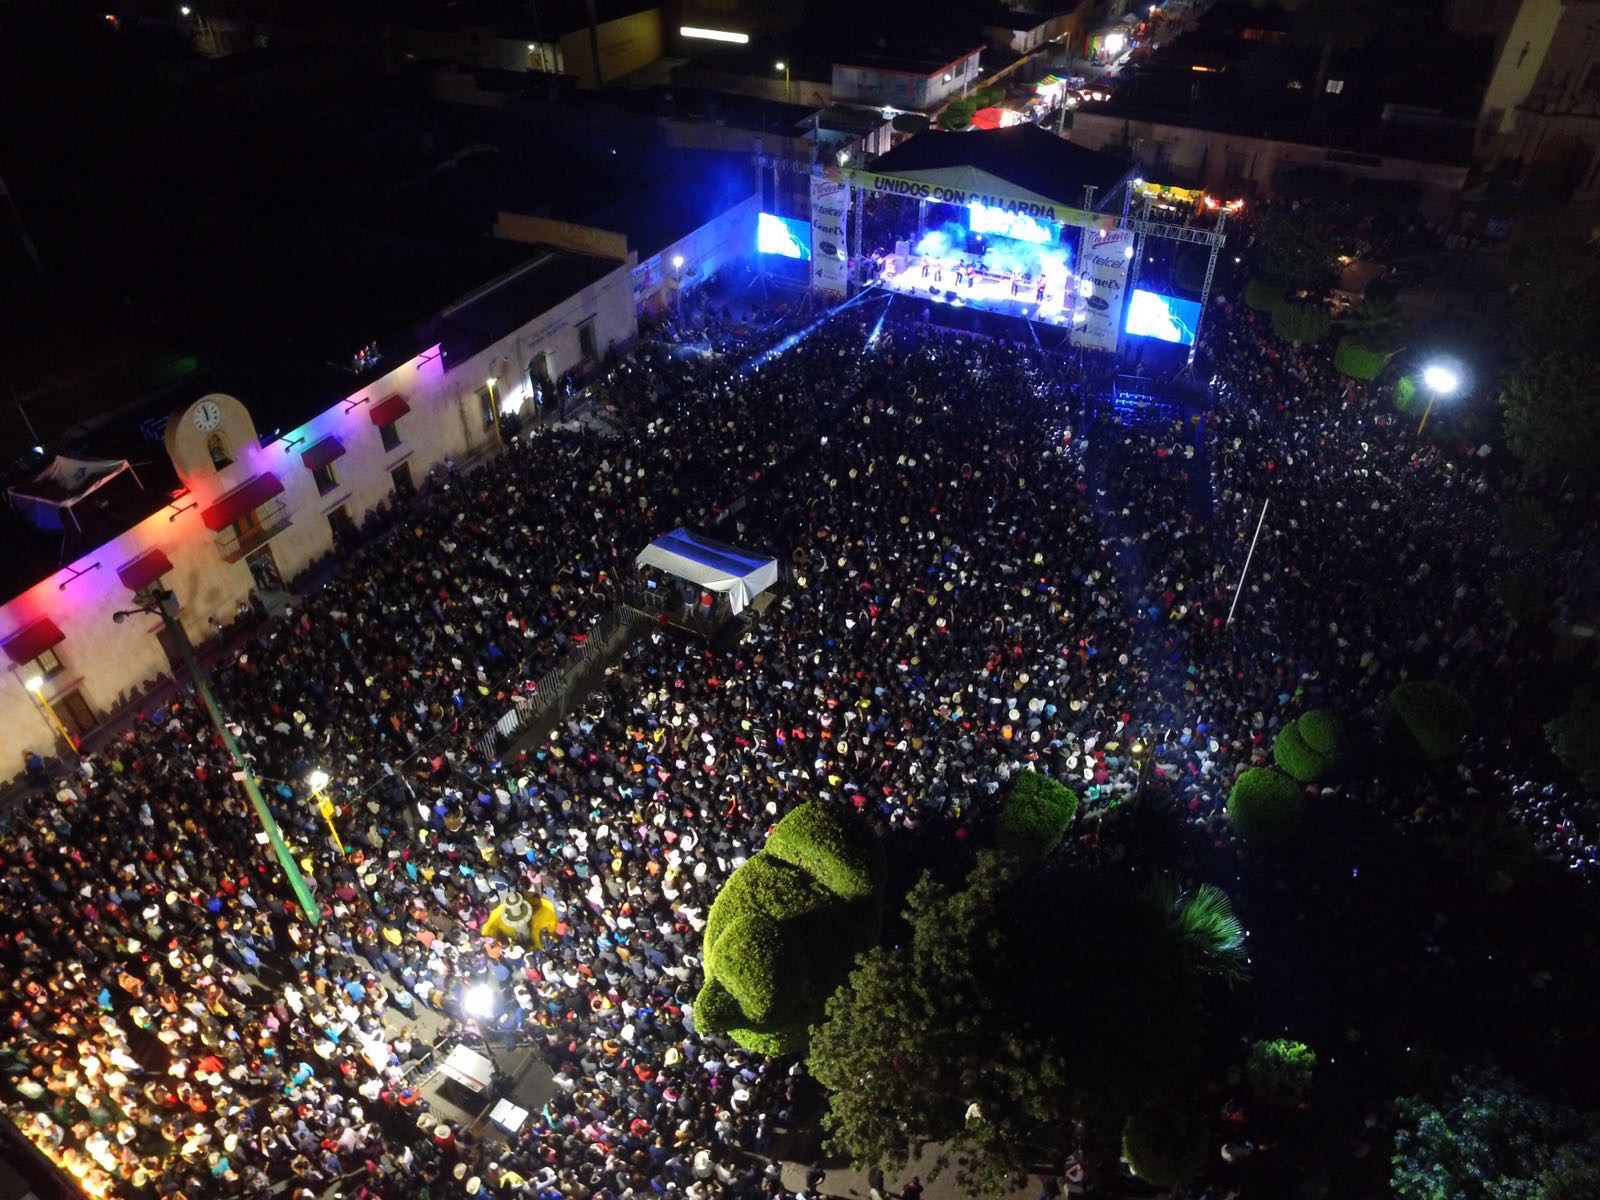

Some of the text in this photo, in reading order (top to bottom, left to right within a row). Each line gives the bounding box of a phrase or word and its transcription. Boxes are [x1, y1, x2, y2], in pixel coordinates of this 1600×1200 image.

[874, 176, 929, 198] UNIDOS
[933, 186, 965, 205] CON
[1092, 255, 1125, 269] telcel
